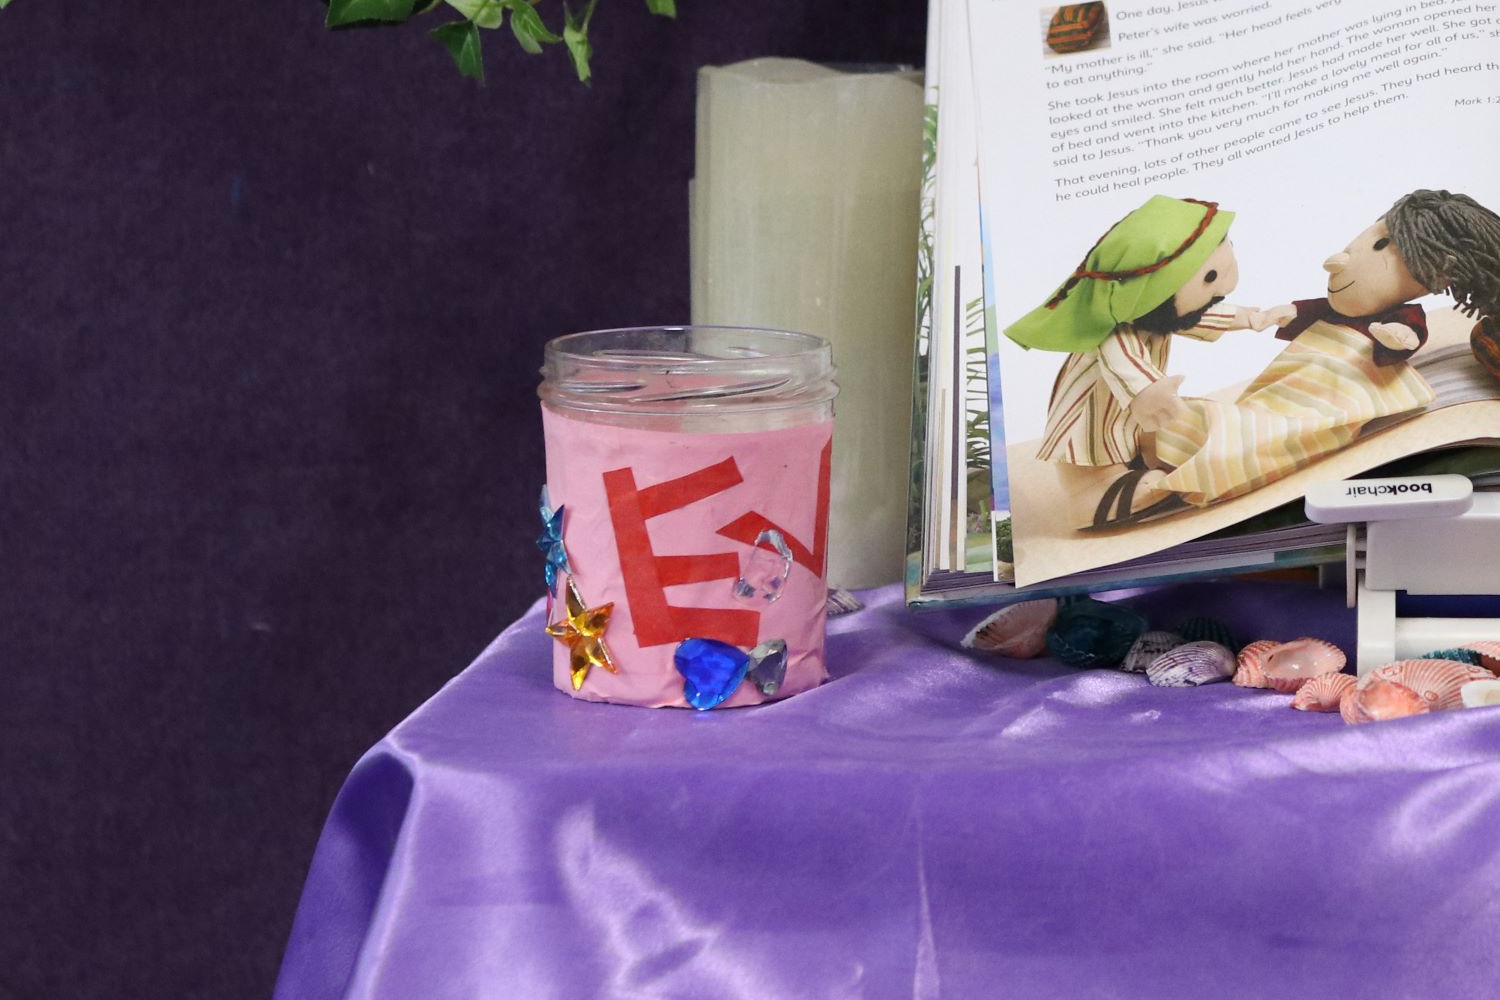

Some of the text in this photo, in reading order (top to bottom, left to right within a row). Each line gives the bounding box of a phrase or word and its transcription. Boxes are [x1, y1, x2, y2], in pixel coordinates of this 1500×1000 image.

[1045, 81, 1060, 89] to
[1062, 76, 1084, 86] eat
[1047, 100, 1071, 110] She
[1074, 92, 1104, 106] took
[1106, 88, 1139, 101] Jesus
[1142, 82, 1168, 92] into
[1170, 76, 1191, 86] the
[1194, 67, 1229, 81] room
[1231, 55, 1270, 74] where
[1273, 47, 1293, 58] her
[1297, 29, 1341, 50] mother
[1344, 21, 1369, 34] was
[1371, 8, 1402, 23] lying
[1405, 4, 1417, 12] in
[1048, 3, 1496, 124] looked at the woman and gently held her hand. The woman opened her
[1049, 127, 1080, 139] eyes
[1082, 119, 1107, 132] and
[1110, 111, 1155, 127] smiled.
[1158, 106, 1182, 117] She
[1184, 99, 1205, 111] felt
[1208, 89, 1243, 105] much
[1246, 77, 1285, 94] better.
[1287, 64, 1318, 81] Jesus
[1321, 51, 1345, 67] had
[1347, 40, 1383, 58] made
[1385, 33, 1406, 44] her
[1409, 22, 1439, 37] well.
[1441, 20, 1466, 33] She
[1469, 17, 1492, 31] got
[1051, 138, 1065, 152] of
[1067, 137, 1092, 150] bed
[1095, 131, 1120, 144] and
[1122, 125, 1155, 138] went
[1158, 120, 1184, 131] into
[1186, 114, 1207, 124] the
[1210, 100, 1257, 118] kitchen.
[1283, 78, 1317, 96] make
[1320, 73, 1329, 81] a
[1331, 59, 1367, 77] lovely
[1370, 46, 1401, 62] meal
[1404, 41, 1422, 52] for
[1425, 35, 1441, 46] all
[1444, 32, 1457, 42] of
[1454, 97, 1482, 106] Mark
[1052, 153, 1078, 166] said
[1081, 152, 1096, 161] to
[1098, 145, 1134, 159] Jesus.
[1187, 126, 1212, 140] you
[1215, 117, 1243, 130] very
[1245, 104, 1280, 121] much
[1282, 97, 1299, 108] for
[1303, 79, 1349, 101] making
[1351, 71, 1371, 83] me
[1374, 59, 1400, 74] well
[1054, 175, 1085, 187] That
[1088, 165, 1140, 181] evening,
[1143, 159, 1167, 169] lots
[1169, 152, 1183, 163] of
[1186, 144, 1220, 159] other
[1223, 130, 1265, 152] people
[1268, 117, 1302, 134] came
[1304, 111, 1318, 120] to
[1321, 102, 1341, 114] see
[1344, 89, 1378, 107] Jesus.
[1380, 77, 1412, 91] They
[1415, 68, 1440, 81] had
[1443, 62, 1482, 75] heard
[1055, 93, 1408, 201] he could heal people. They all wanted Jesus to help them.
[1345, 482, 1433, 498] bookchair
